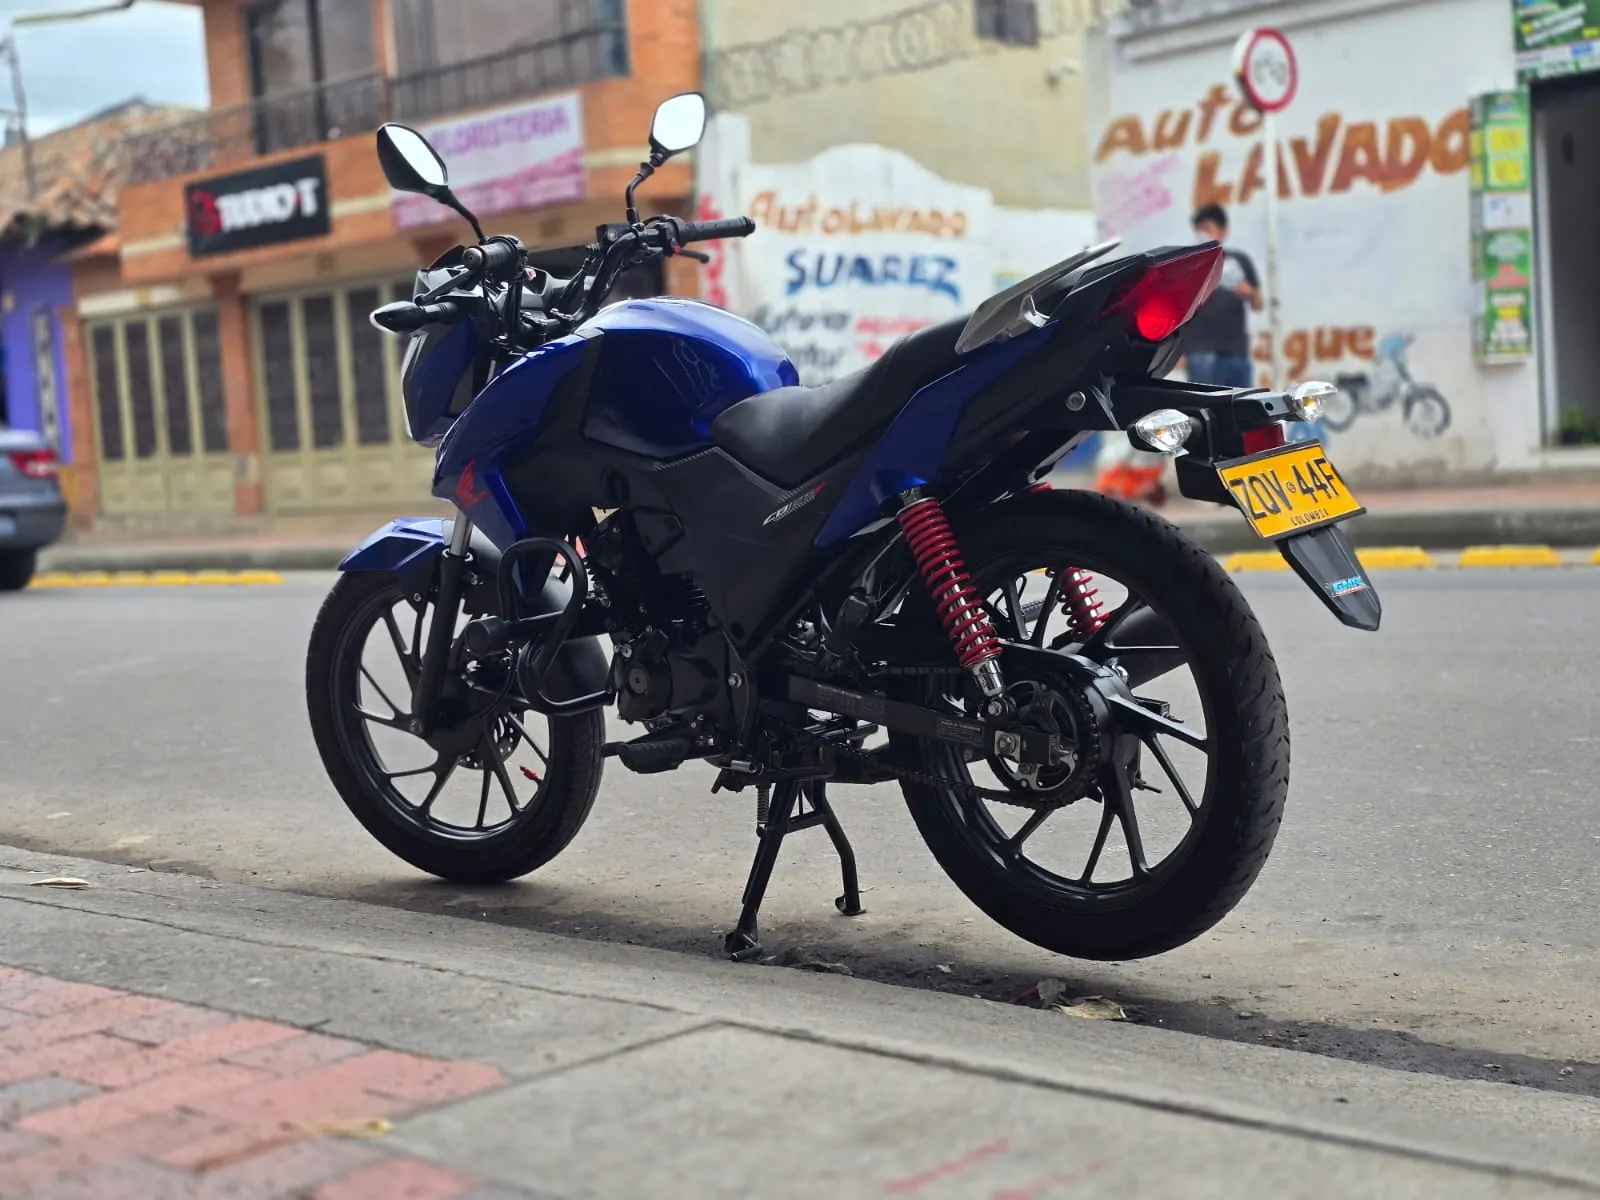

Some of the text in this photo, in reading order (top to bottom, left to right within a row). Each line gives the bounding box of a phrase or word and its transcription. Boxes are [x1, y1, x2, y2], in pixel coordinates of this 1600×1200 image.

[784, 248, 963, 304] SUAREZ
[1292, 458, 1339, 503] 44F
[1291, 508, 1329, 526] COLOMBIA
